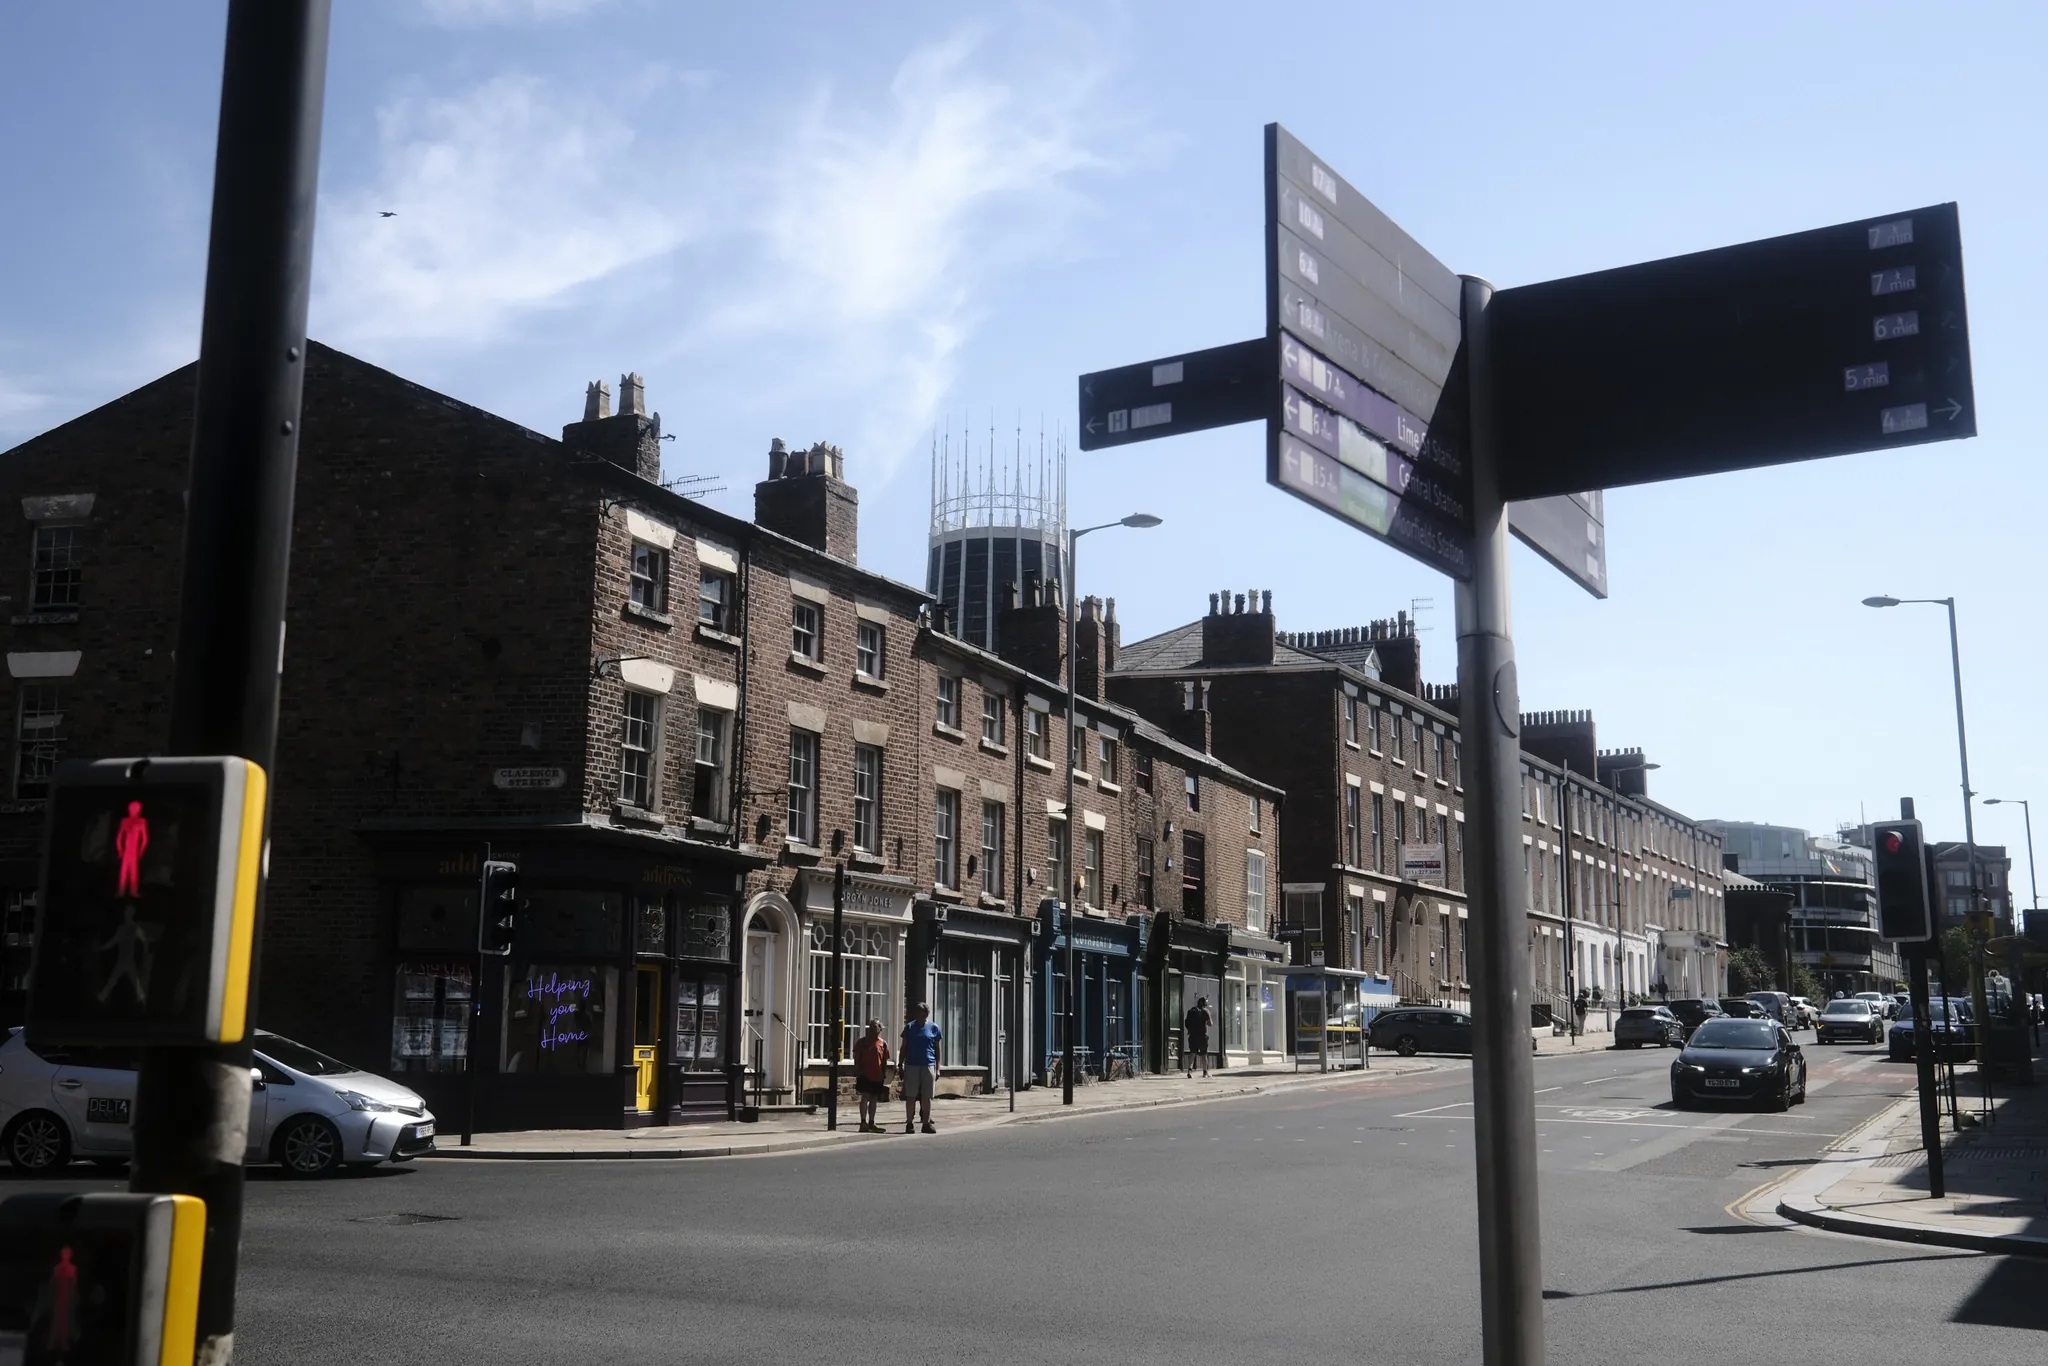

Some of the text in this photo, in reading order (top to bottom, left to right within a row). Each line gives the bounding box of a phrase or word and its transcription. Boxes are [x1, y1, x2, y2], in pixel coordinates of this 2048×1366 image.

[1299, 200, 1311, 227] 10
[1868, 228, 1912, 248] 7 min
[1299, 249, 1306, 273] 6
[1871, 273, 1915, 292] 7 min
[1875, 318, 1917, 338] 6 min
[1324, 318, 1358, 362] Arena
[1326, 369, 1333, 391] 7
[1846, 368, 1888, 388] 5 min
[1313, 413, 1320, 434] 6
[1883, 411, 1926, 430] 4 min
[1397, 415, 1420, 451] Lime
[1421, 432, 1431, 458] St
[1314, 464, 1326, 487] 15
[1399, 464, 1464, 521] Central Station
[1437, 531, 1464, 566] Station
[500, 769, 559, 778] CLARENCE
[508, 778, 551, 787] STREET
[643, 864, 692, 887] address
[842, 891, 867, 904] ORGAN
[870, 896, 893, 908] JONES
[1075, 932, 1112, 949] CUTHBERT'S
[528, 972, 590, 1002] Helping
[550, 1004, 576, 1025] you
[541, 1025, 588, 1052] Home
[90, 1098, 128, 1114] DELTA
